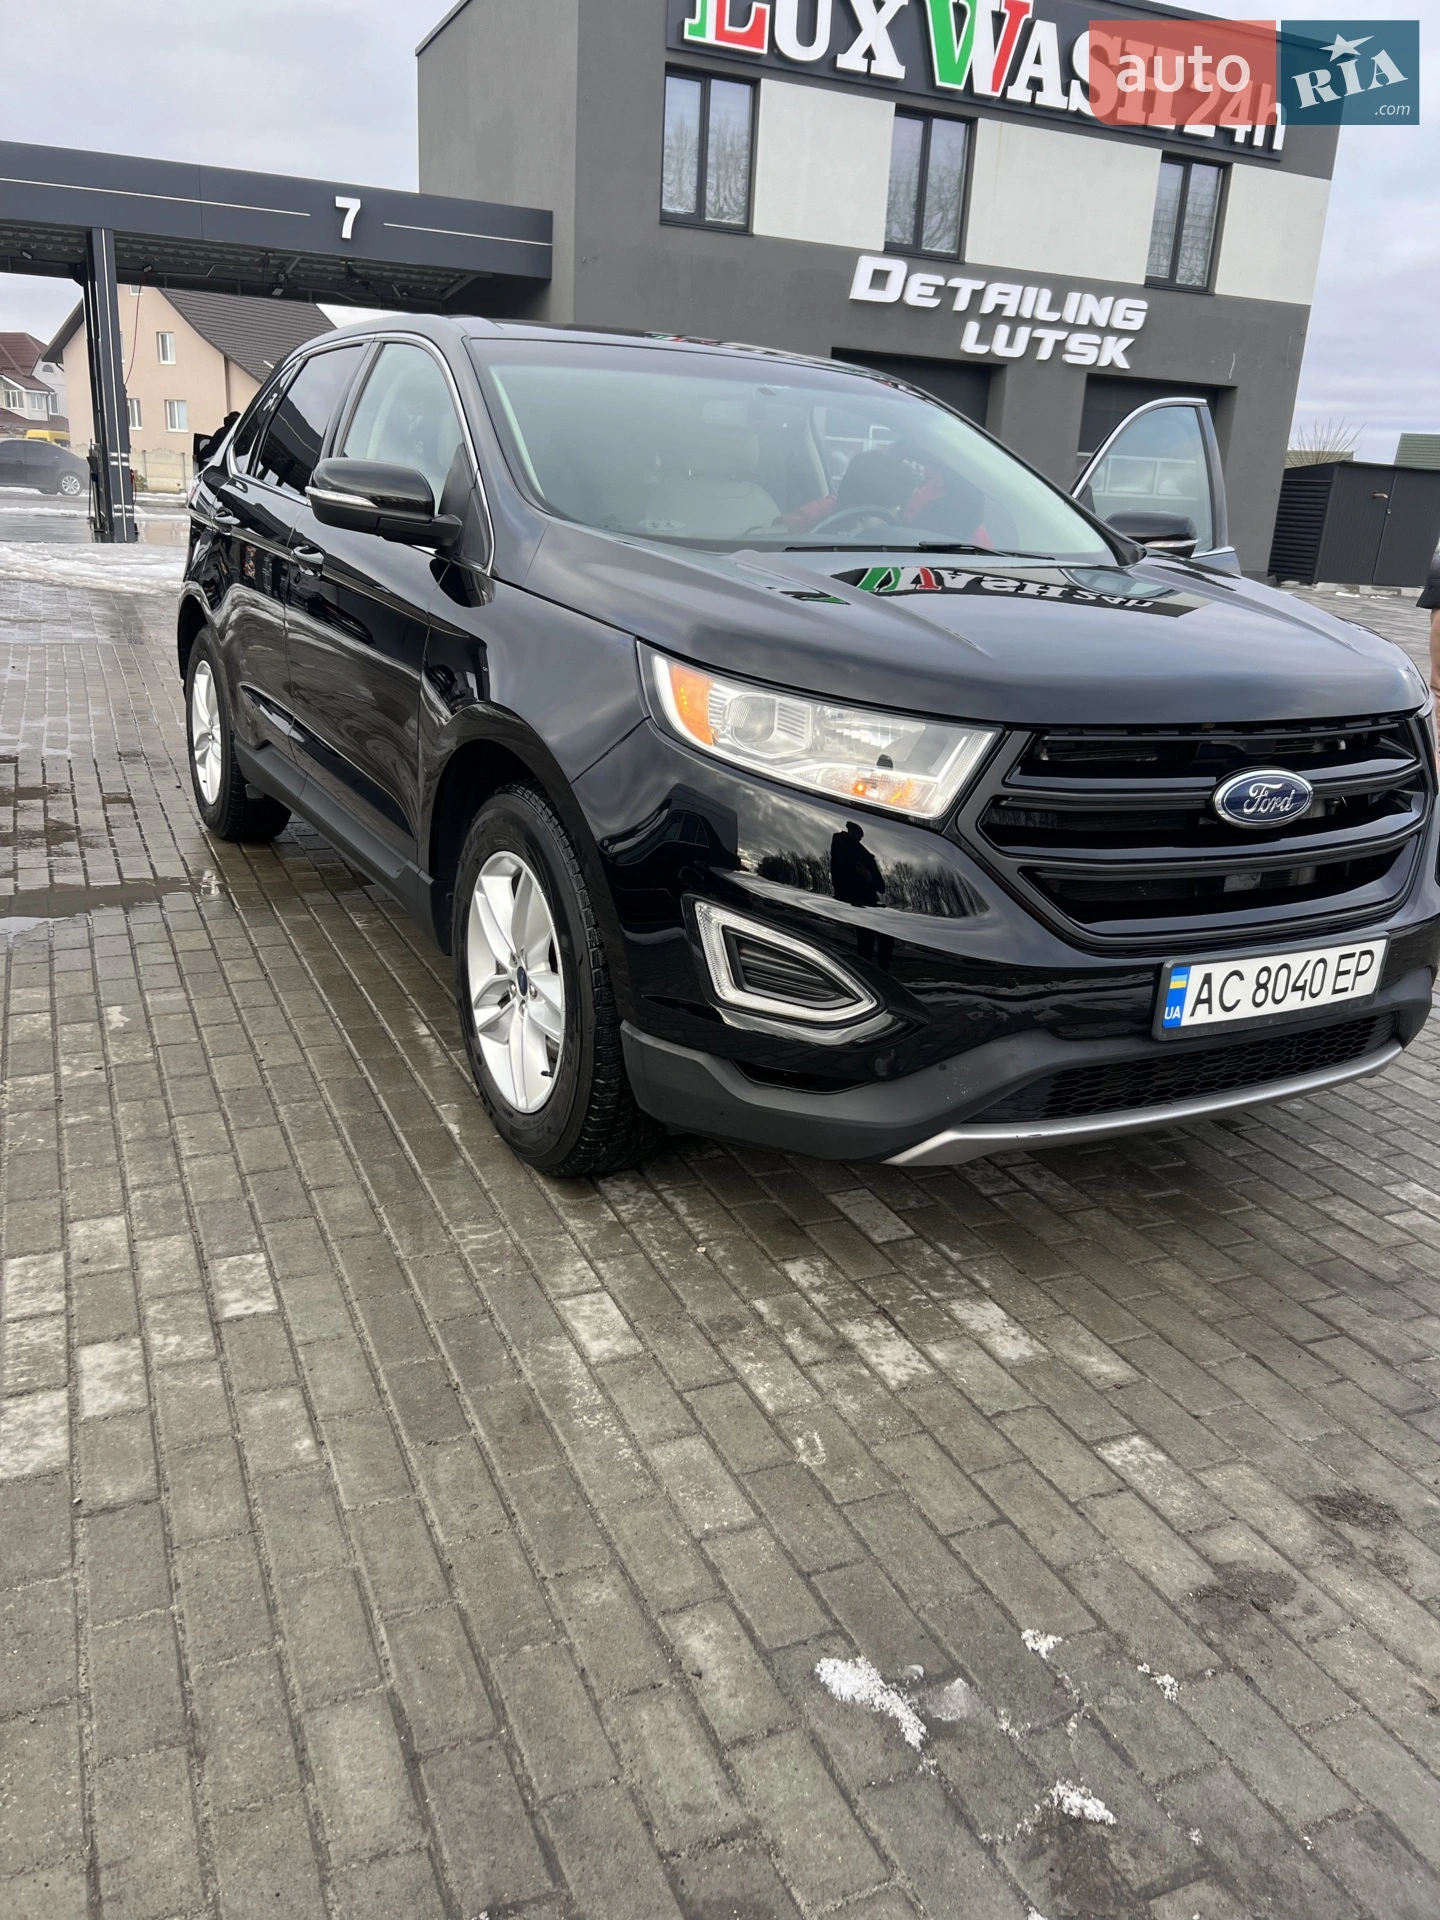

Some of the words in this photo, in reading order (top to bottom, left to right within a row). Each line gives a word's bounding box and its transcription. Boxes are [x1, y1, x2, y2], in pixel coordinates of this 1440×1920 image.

[1182, 70, 1288, 151] 24h
[335, 196, 361, 239] 7
[849, 255, 1149, 331] DETAILING
[960, 320, 1136, 370] LUTSK
[1243, 782, 1296, 815] Ford
[1164, 1005, 1182, 1020] UA
[1189, 969, 1245, 1018] AC
[1251, 956, 1328, 1009] 8040
[1331, 949, 1375, 996] EP
